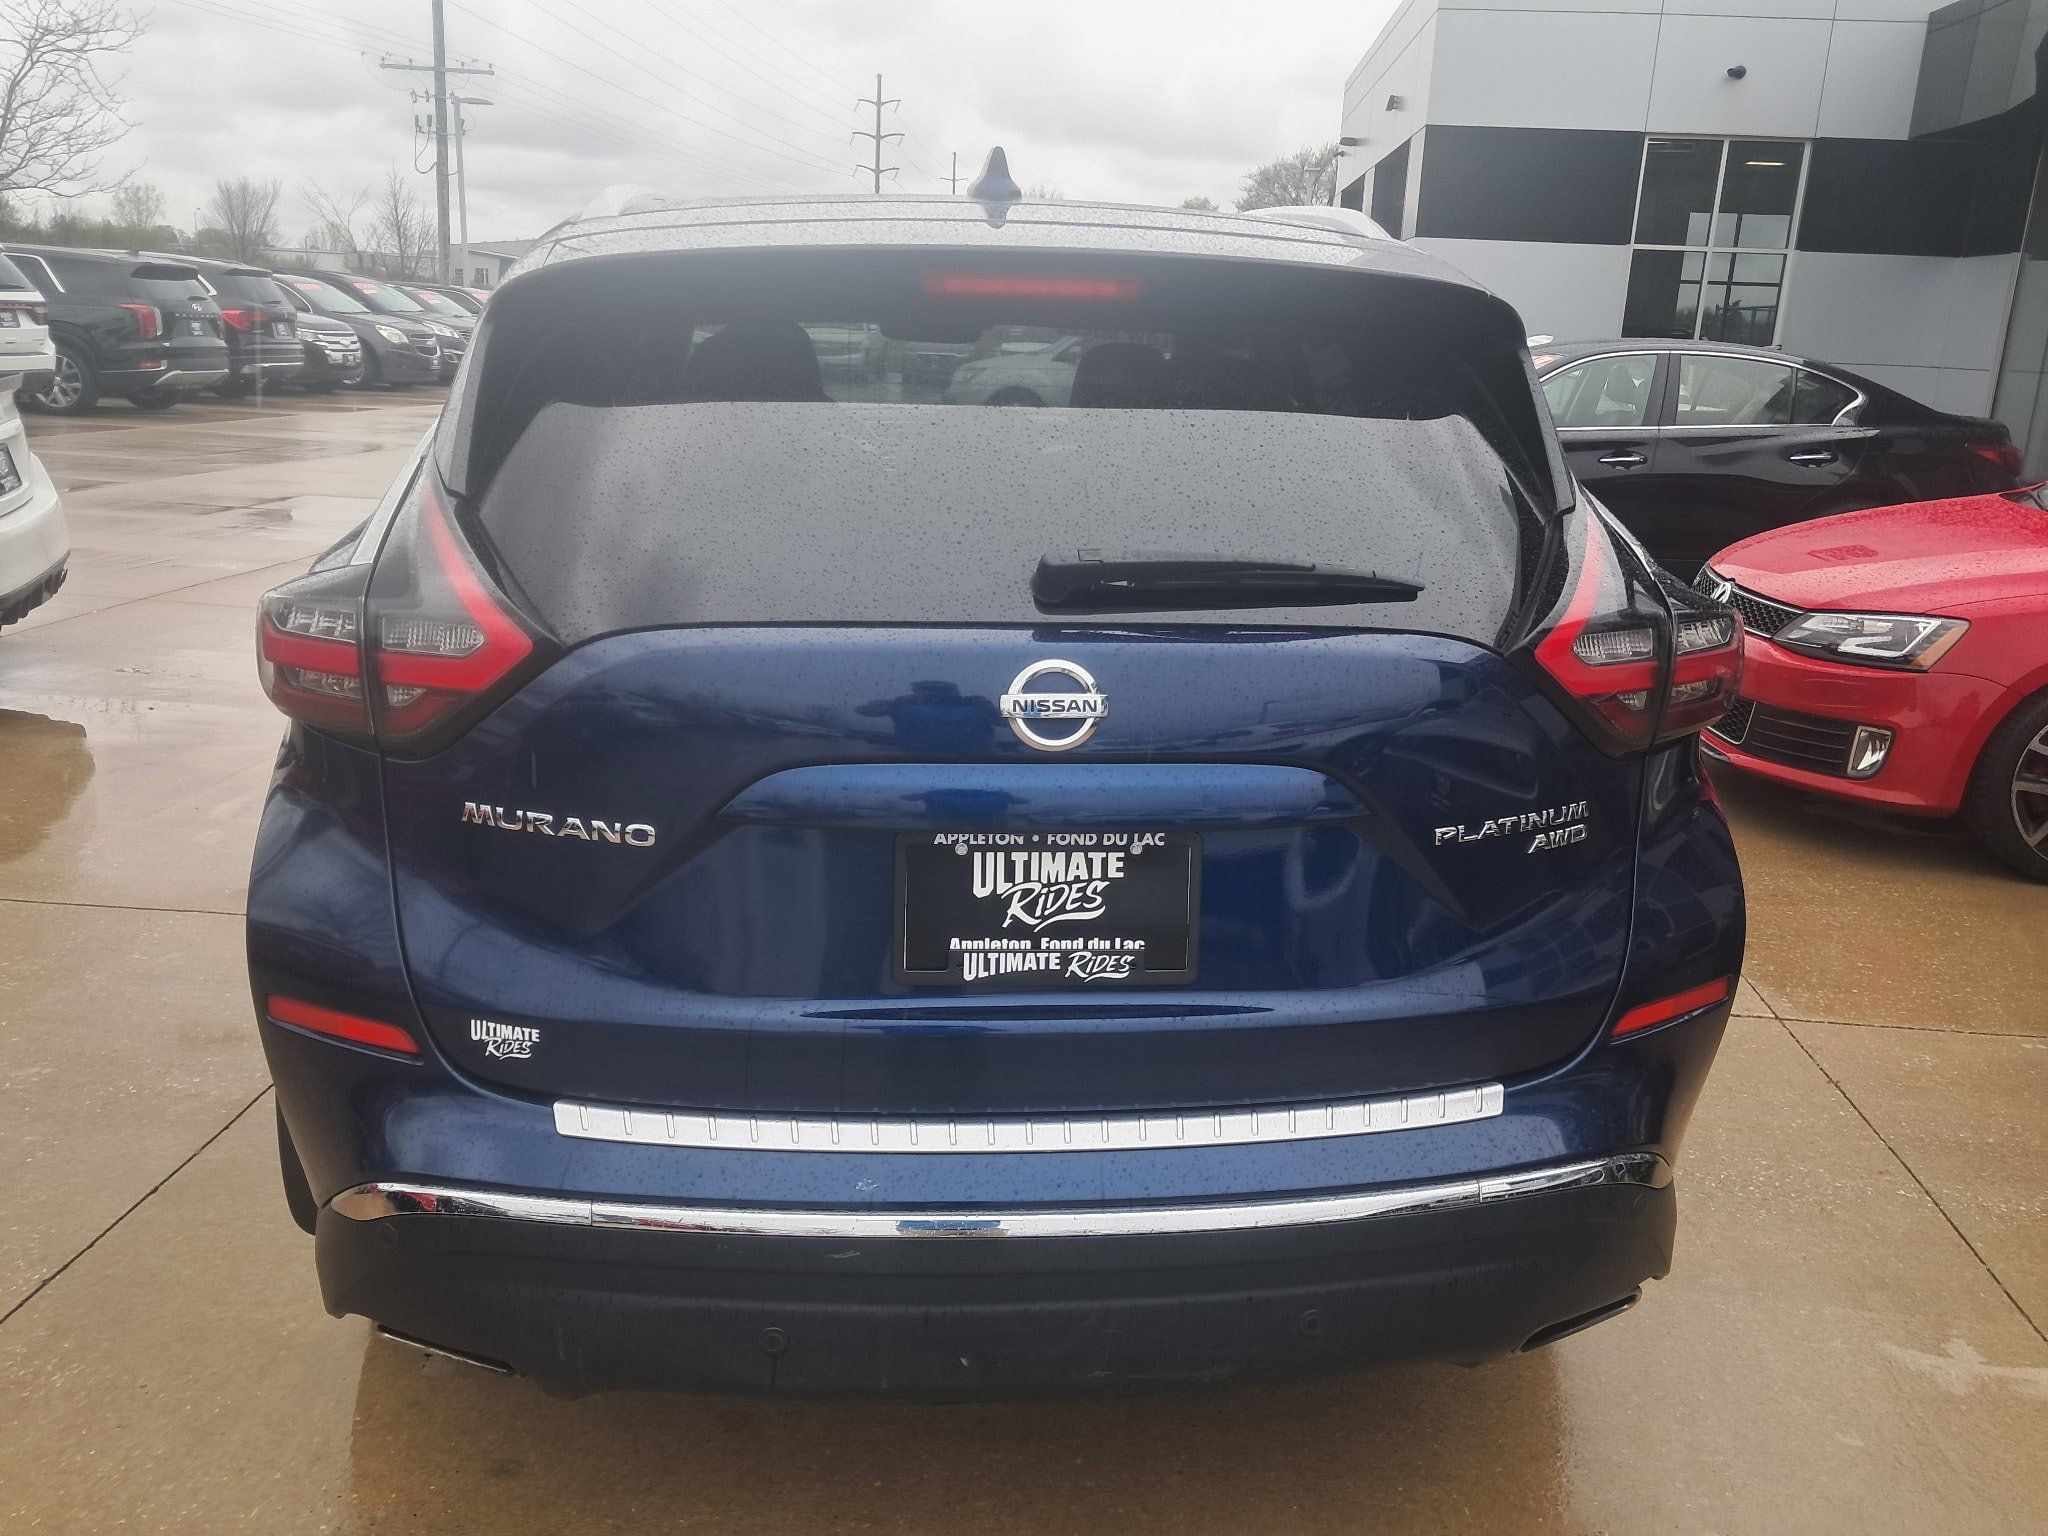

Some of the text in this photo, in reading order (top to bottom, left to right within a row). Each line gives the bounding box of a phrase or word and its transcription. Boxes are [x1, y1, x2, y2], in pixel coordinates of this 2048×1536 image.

[1012, 699, 1098, 713] NISSAN
[461, 801, 656, 847] MURANO
[1434, 801, 1589, 846] PLATINUM
[933, 832, 1165, 846] APPLETON FOND DU LAC
[1526, 824, 1589, 854] AWD
[972, 851, 1125, 899] ULTIMATE
[963, 952, 1061, 982] ULTIMATE
[470, 1019, 540, 1043] ULTIMATE
